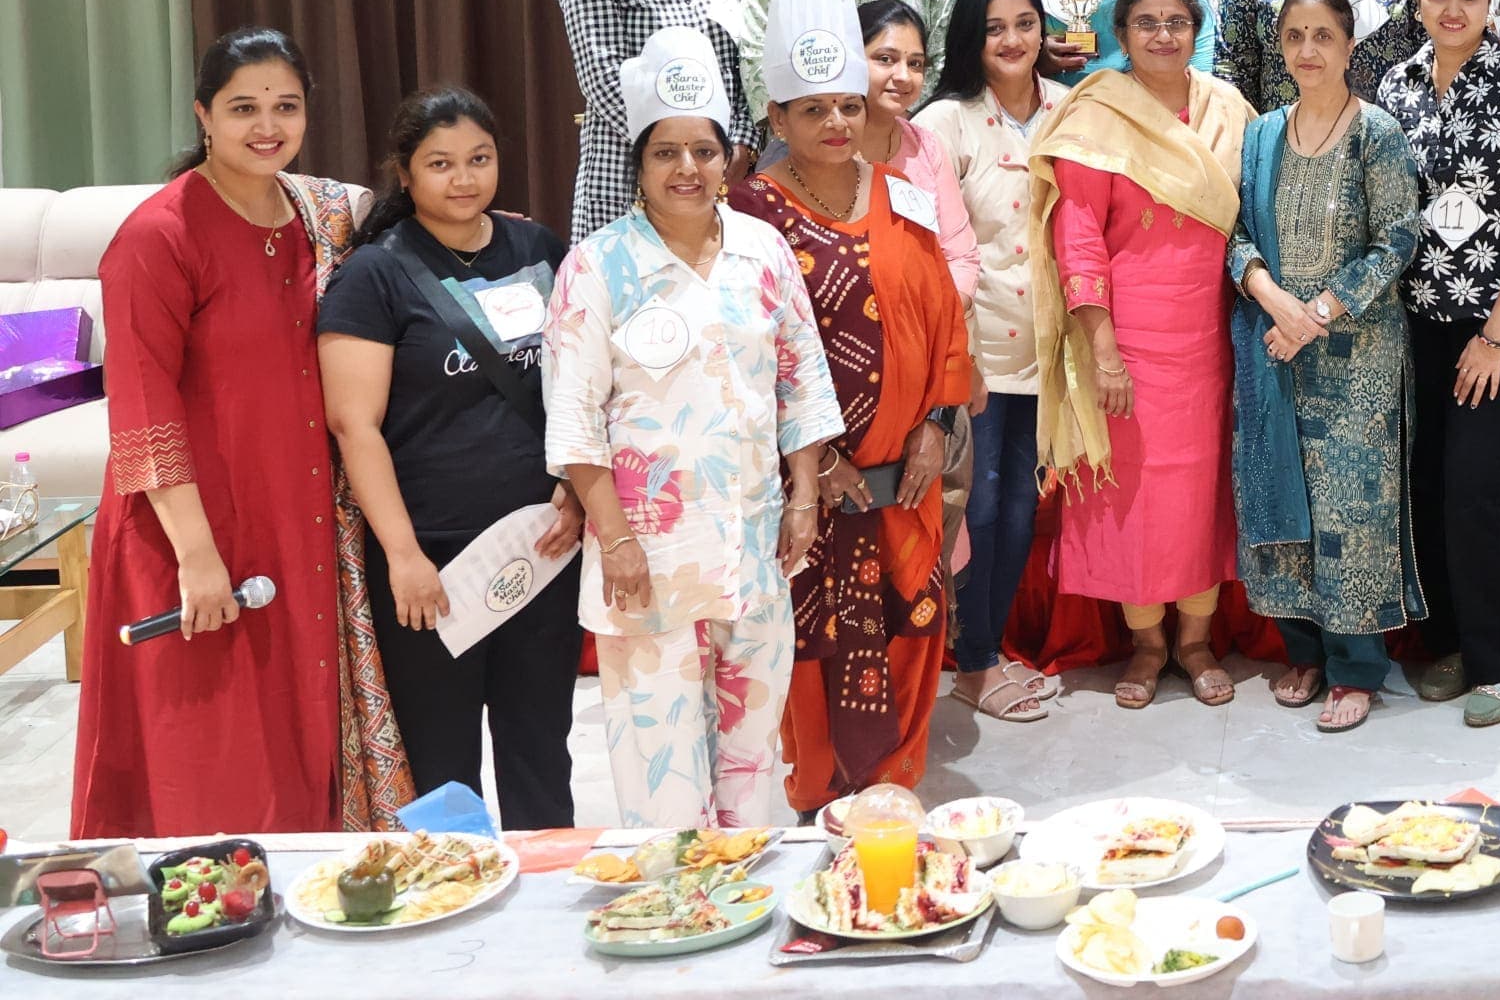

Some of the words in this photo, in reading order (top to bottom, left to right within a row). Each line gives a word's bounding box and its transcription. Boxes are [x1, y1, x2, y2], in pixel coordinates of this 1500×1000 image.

[800, 45, 839, 57] #Sara's
[802, 55, 838, 66] Master
[807, 64, 831, 78] Chef
[668, 84, 705, 93] Master
[673, 92, 698, 105] Chef
[1438, 200, 1465, 230] 11
[499, 573, 527, 603] Master
[506, 586, 526, 606] Chef
[431, 939, 486, 973] 3
